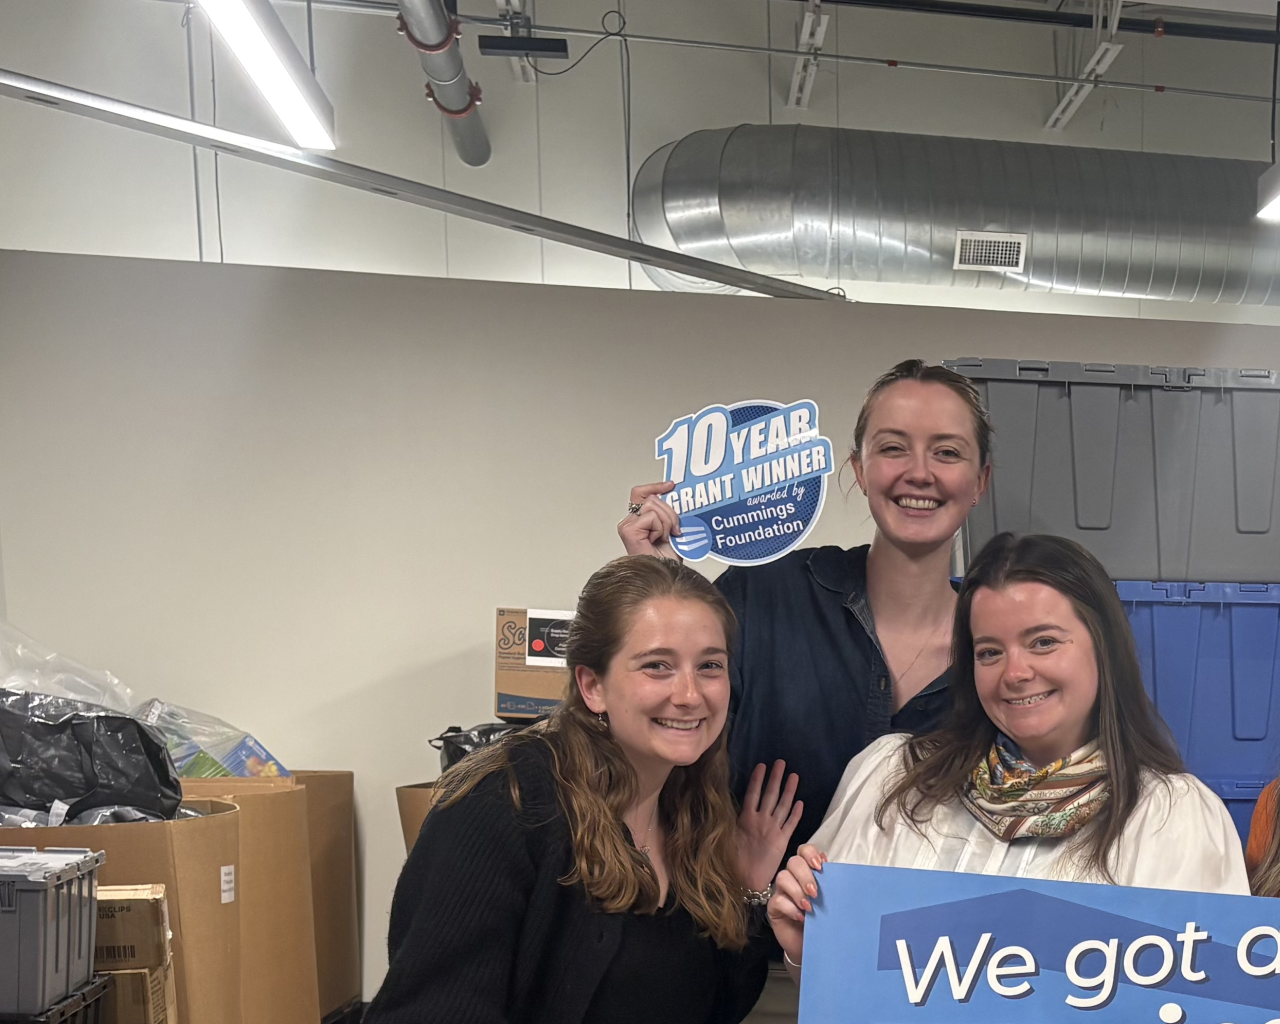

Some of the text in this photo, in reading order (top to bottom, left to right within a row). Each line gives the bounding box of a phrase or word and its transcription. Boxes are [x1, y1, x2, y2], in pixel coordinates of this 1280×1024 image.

[661, 408, 818, 484] 10 YEAR
[666, 446, 826, 515] GRANT WINNER
[747, 484, 806, 506] awarded by
[711, 503, 795, 531] Cummings
[716, 519, 804, 549] Foundation
[896, 933, 1038, 1004] We
[1065, 922, 1208, 1008] got
